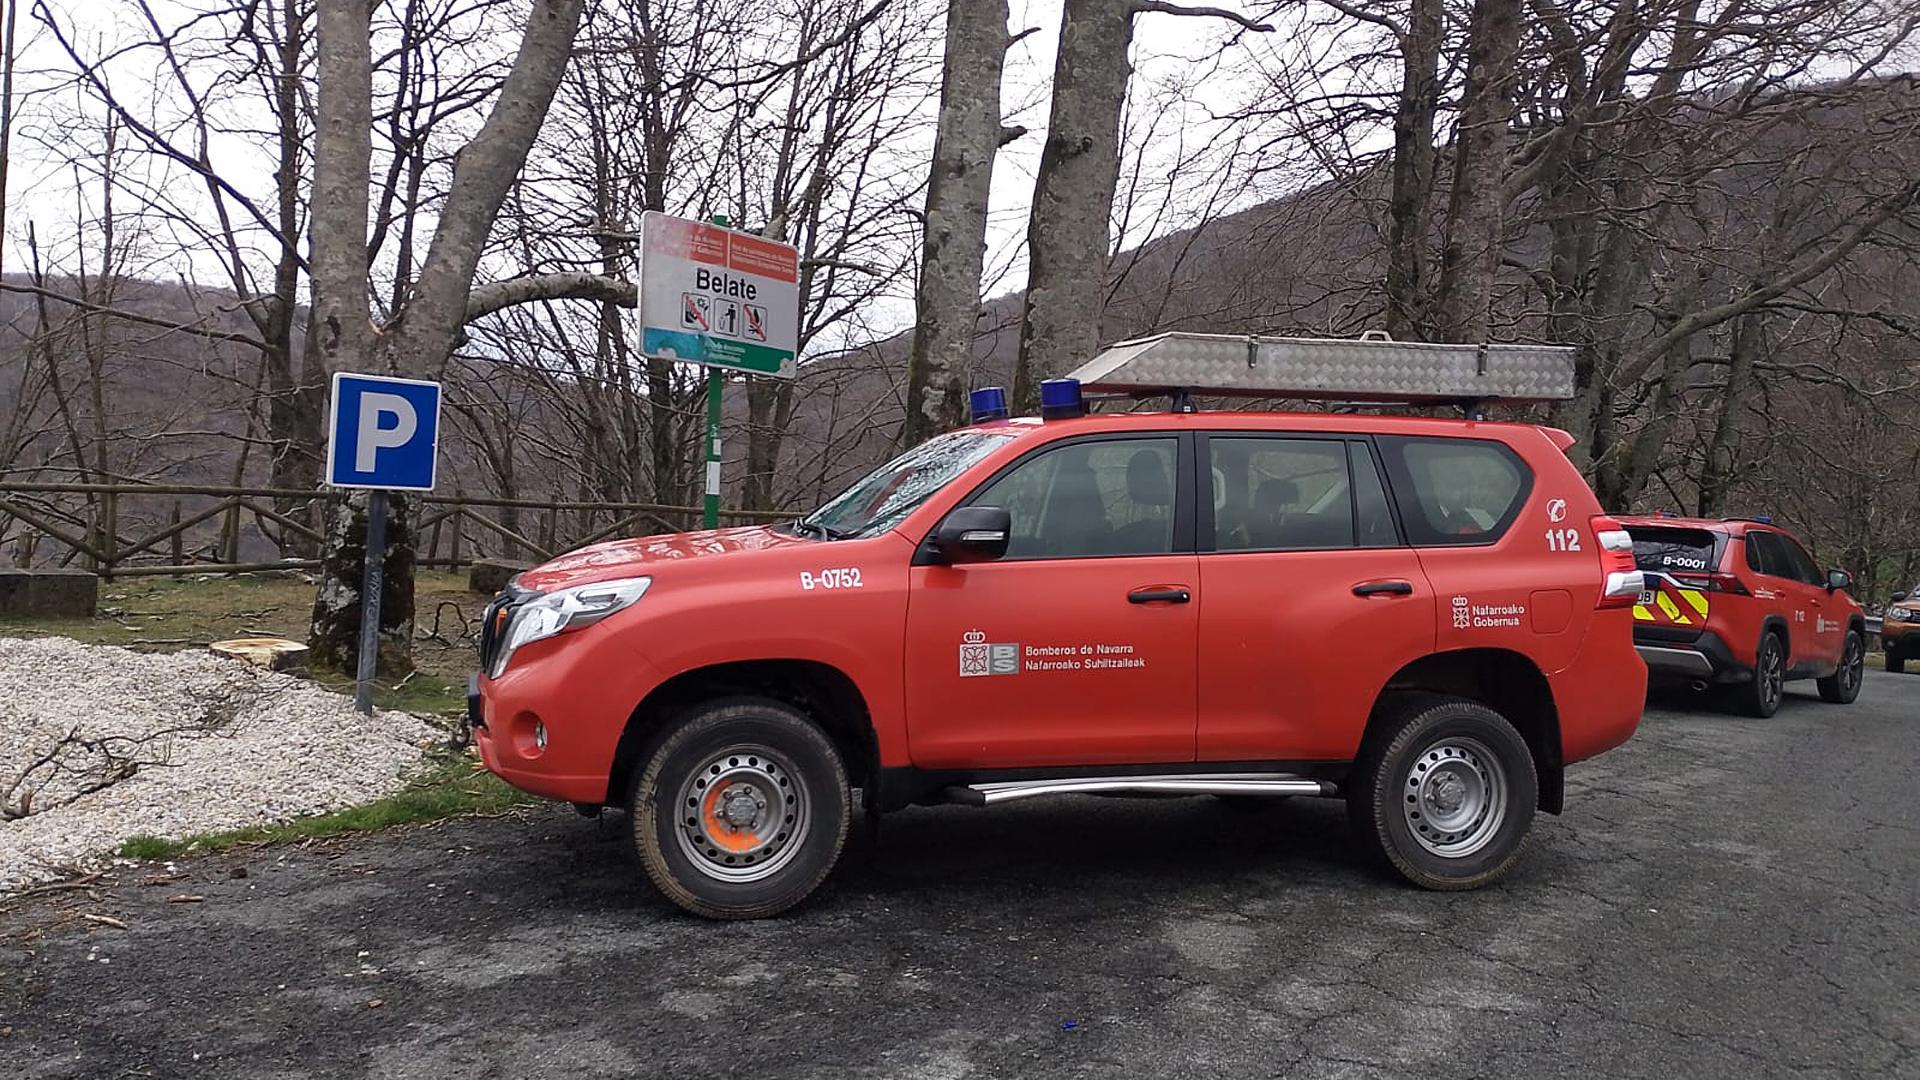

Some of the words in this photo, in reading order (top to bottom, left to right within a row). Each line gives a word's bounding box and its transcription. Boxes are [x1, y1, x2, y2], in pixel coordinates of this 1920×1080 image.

[696, 267, 757, 300] Belate
[355, 391, 418, 473] P
[1545, 529, 1581, 551] 112
[1662, 556, 1706, 569] B-0001
[800, 567, 863, 590] B-0752
[1472, 604, 1525, 616] Nafarroako
[1473, 616, 1520, 628] Gobernua
[1025, 646, 1077, 656] Bomberos
[1080, 645, 1093, 655] de
[1096, 644, 1134, 654] Navarra
[1025, 660, 1081, 671] Nafarroako
[1084, 657, 1146, 669] Suhiltzaileak
